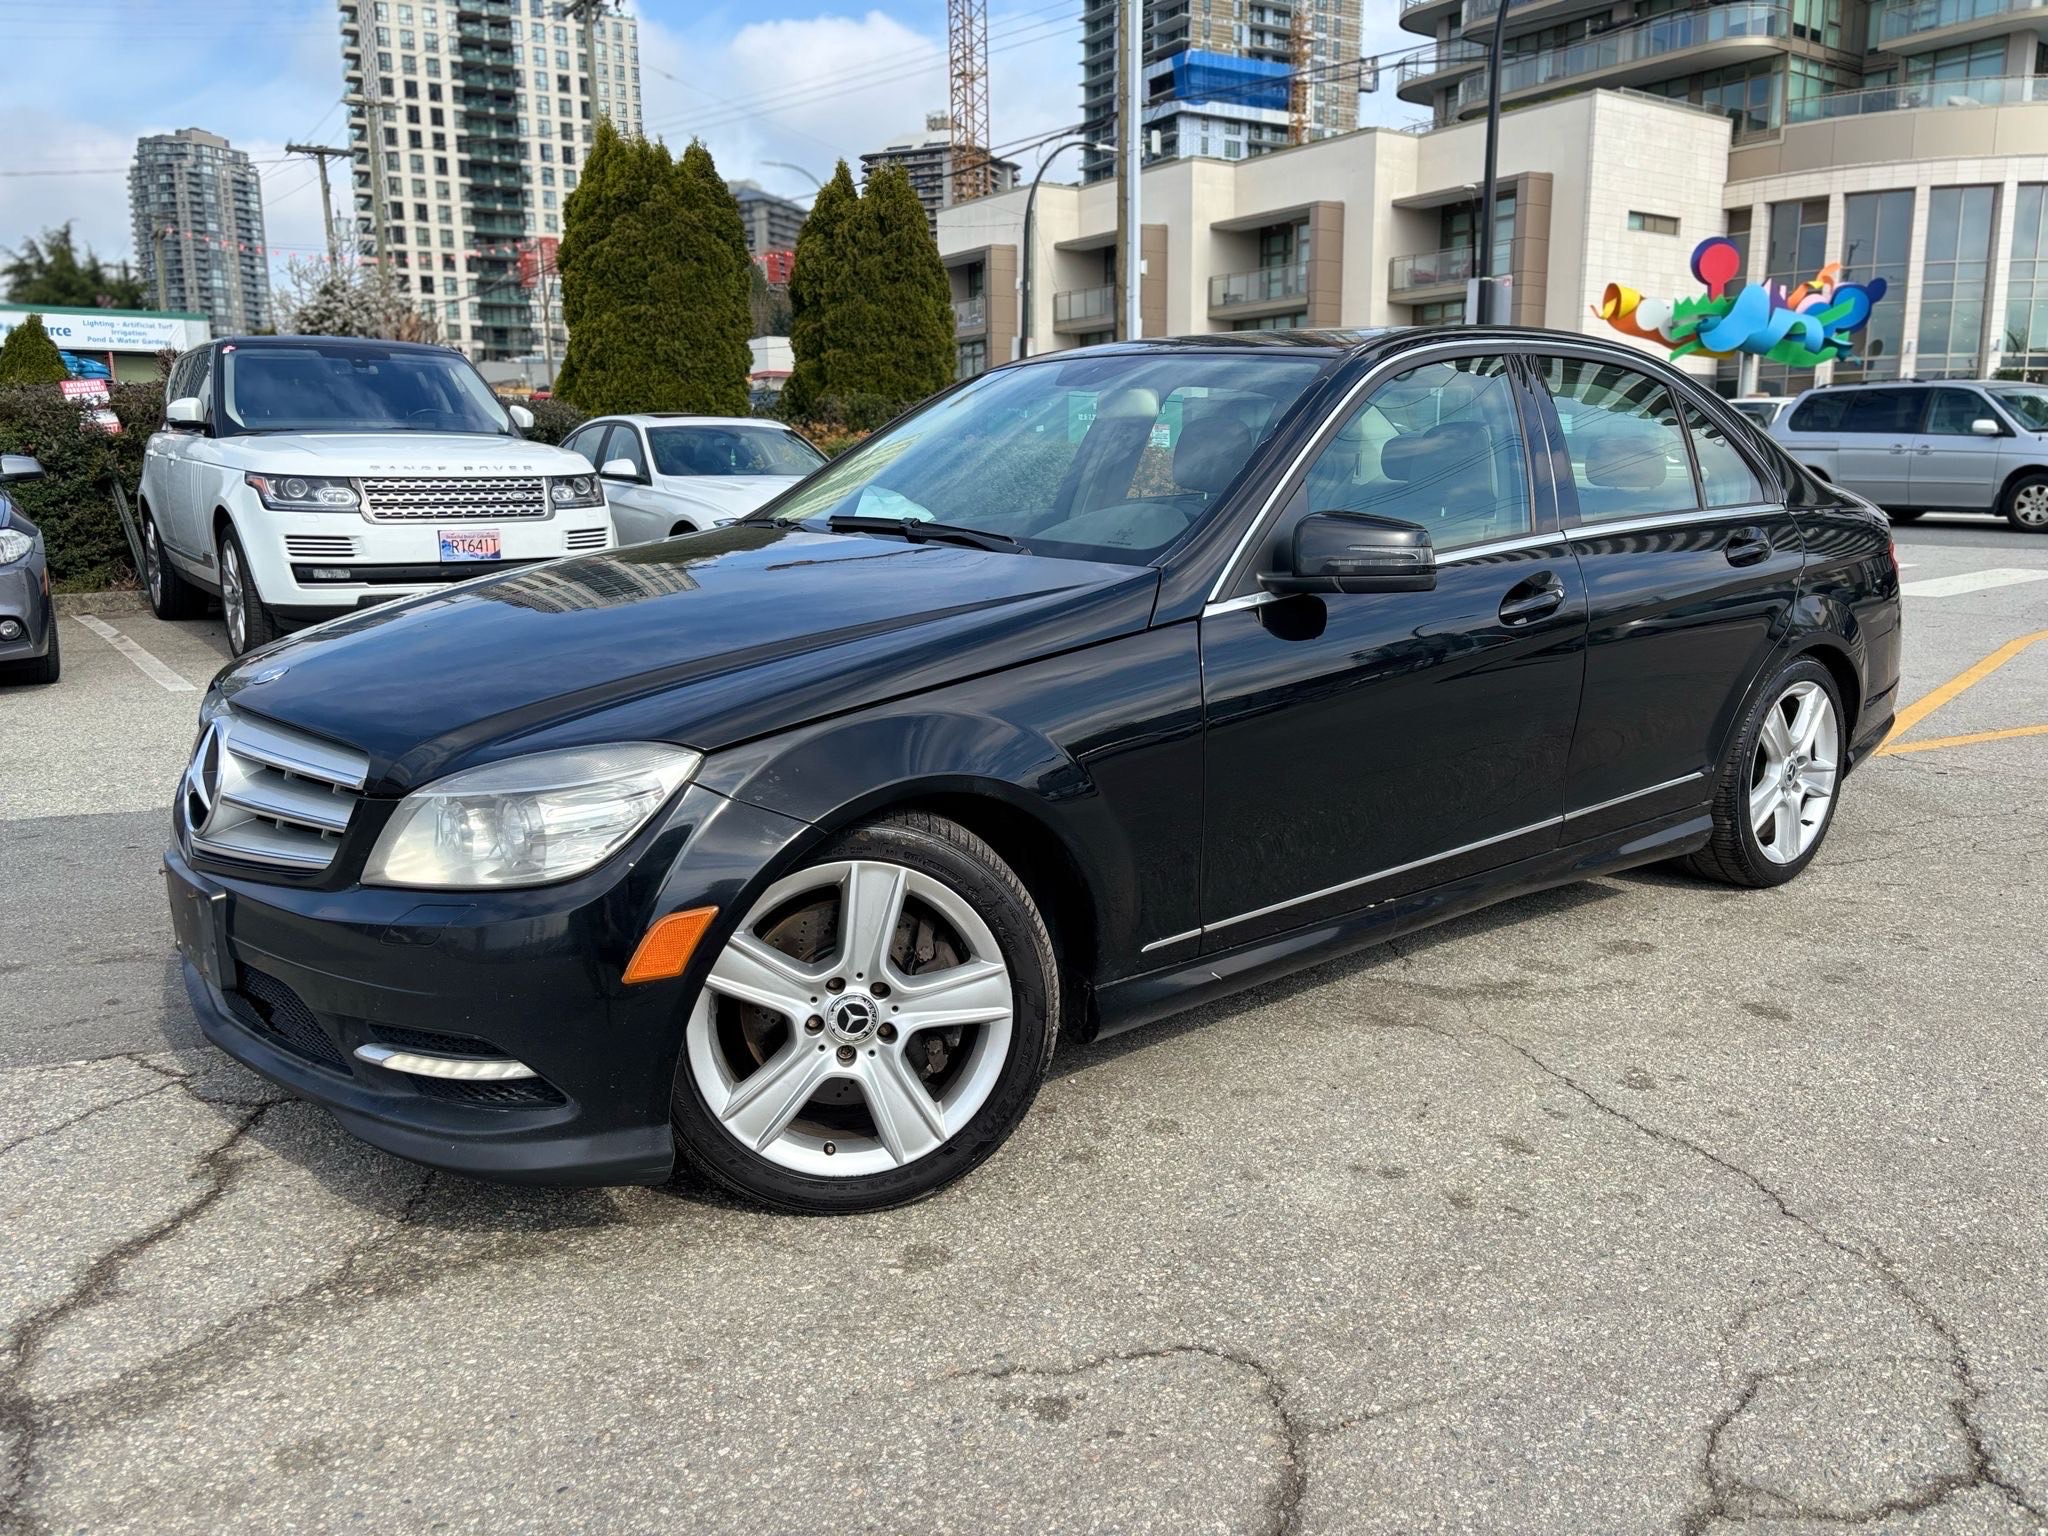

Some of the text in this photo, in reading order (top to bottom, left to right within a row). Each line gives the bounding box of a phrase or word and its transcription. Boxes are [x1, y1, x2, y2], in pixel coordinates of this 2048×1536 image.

[82, 319, 115, 328] Lighting
[122, 321, 156, 329] Artificial
[111, 328, 148, 337] Irrigation
[87, 335, 106, 343] Pond
